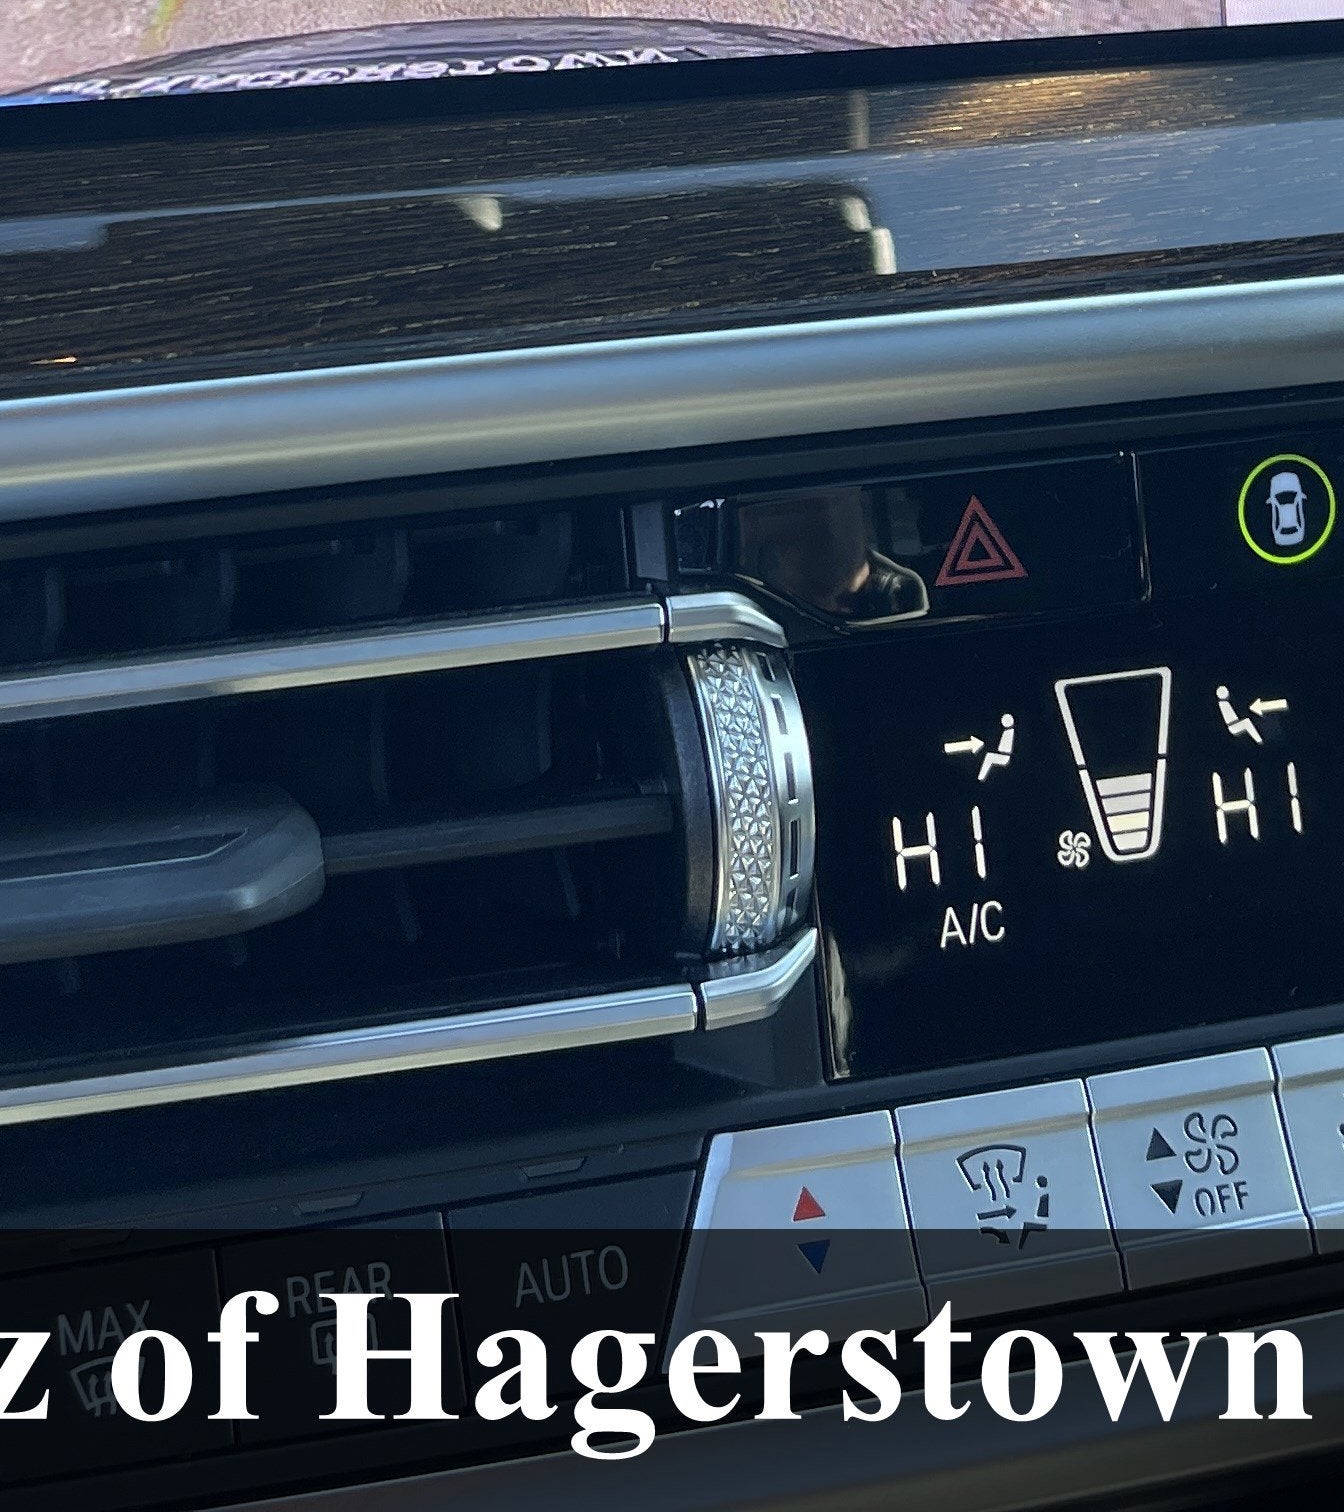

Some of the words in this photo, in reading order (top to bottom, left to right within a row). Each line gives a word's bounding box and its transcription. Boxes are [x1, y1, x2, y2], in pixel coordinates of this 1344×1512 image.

[939, 899, 1007, 950] A/C
[1193, 1180, 1251, 1218] OFF
[285, 1260, 394, 1320] REAR
[514, 1243, 631, 1310] AUTO
[55, 1298, 154, 1357] MAX
